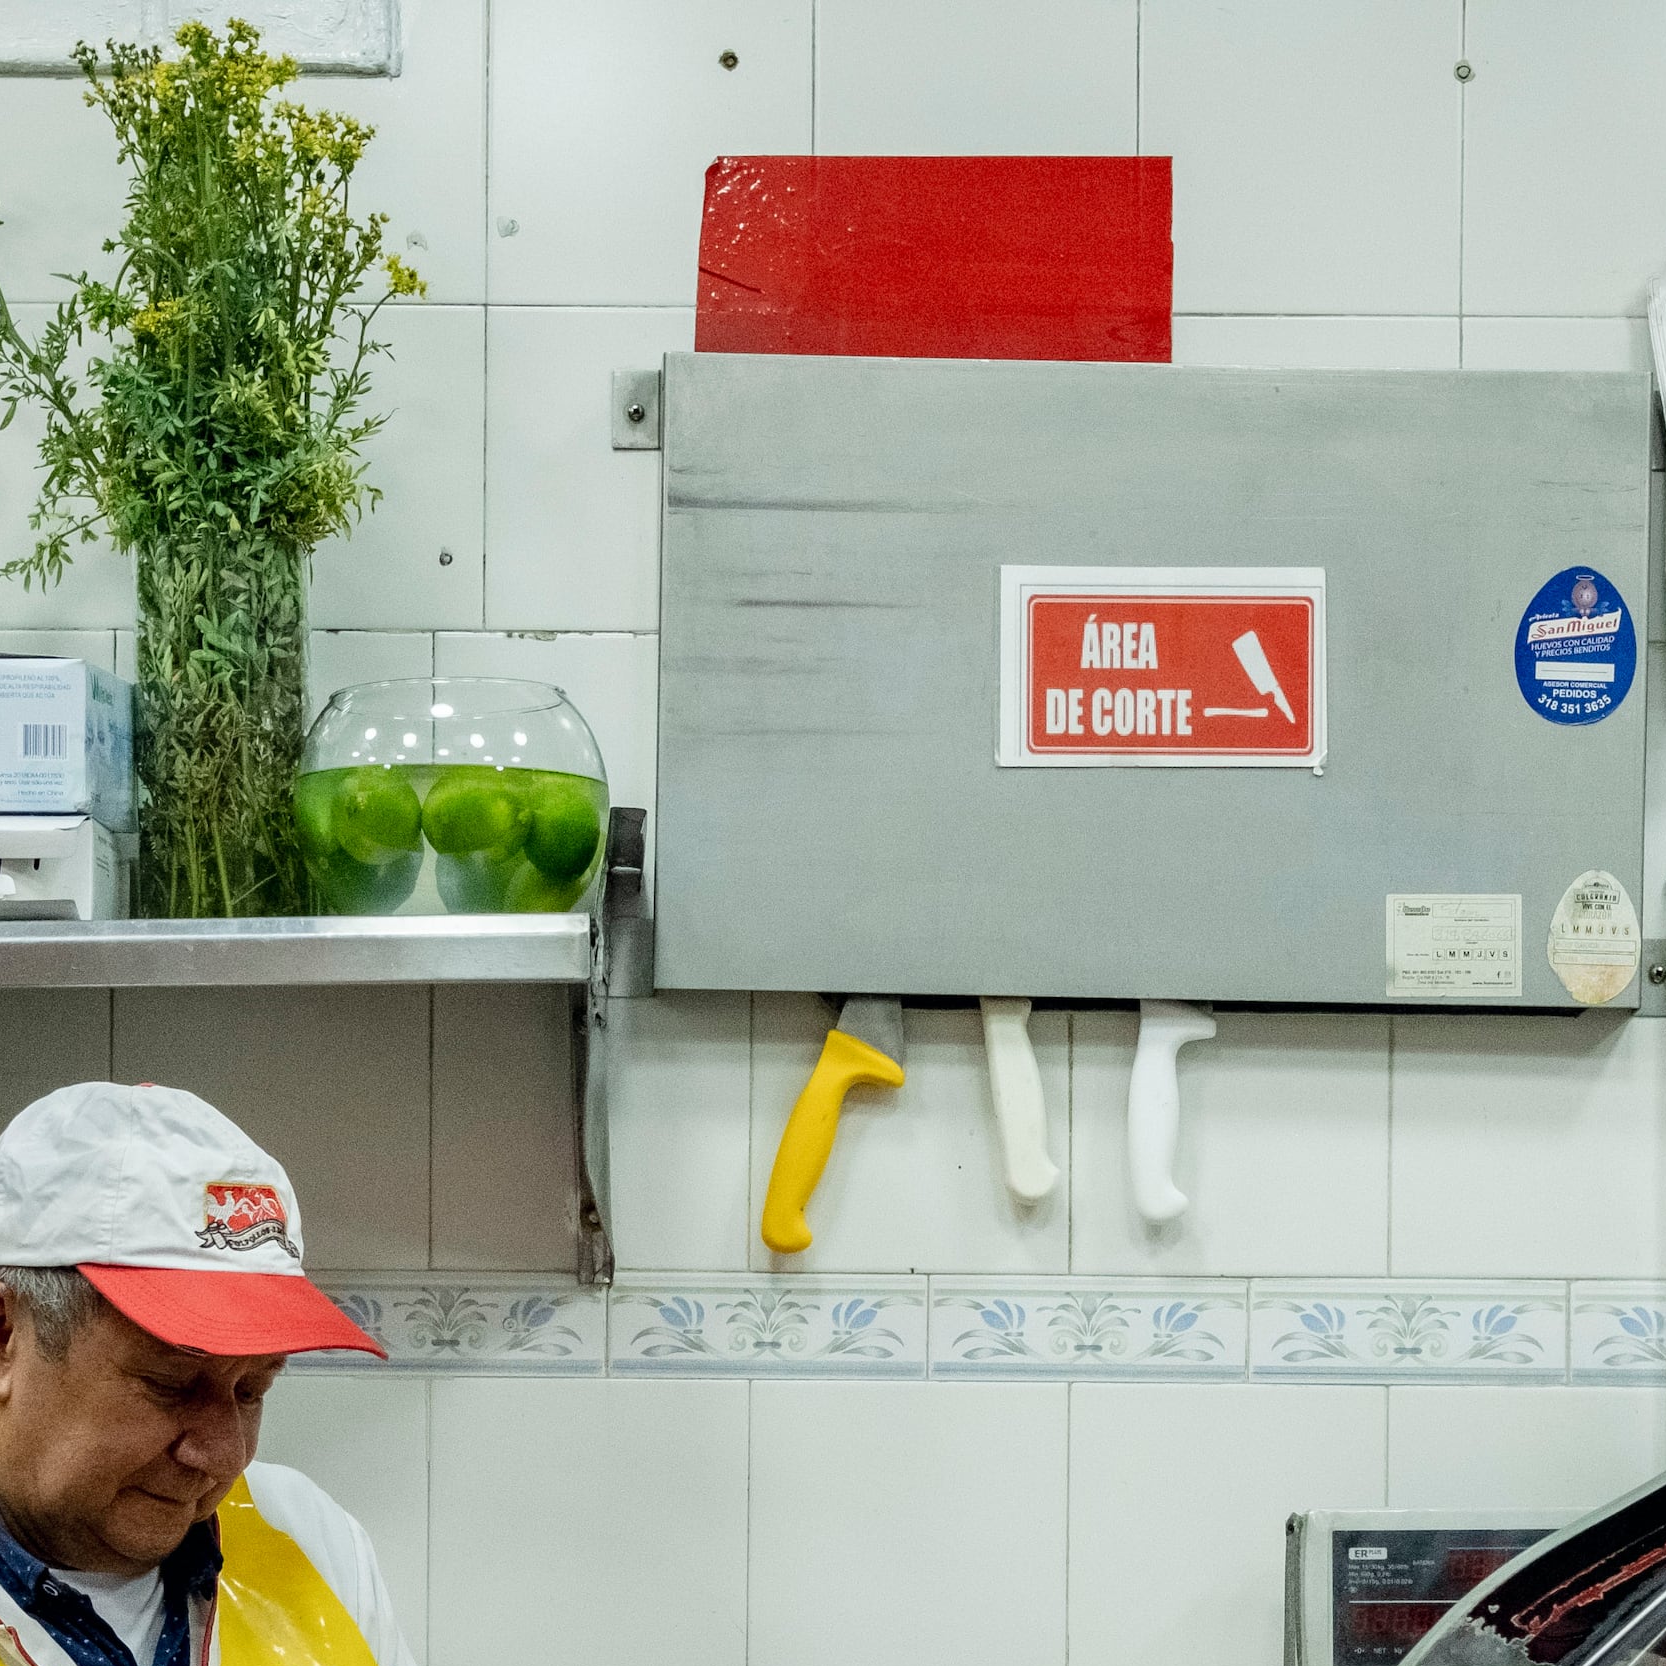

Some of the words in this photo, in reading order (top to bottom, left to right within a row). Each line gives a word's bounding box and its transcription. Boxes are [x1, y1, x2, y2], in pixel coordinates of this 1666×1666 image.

[1565, 618, 1618, 634] Miguel
[1080, 613, 1158, 670] ÁREA
[1531, 640, 1563, 651] HUEVOS
[1562, 638, 1581, 649] CON
[1581, 635, 1615, 647] CALIDAD
[1534, 651, 1541, 659] Y
[1541, 646, 1573, 658] PRECIOS
[1573, 643, 1611, 656] BENDITOS
[1552, 688, 1597, 699] PEDIDOS
[1045, 688, 1084, 735] DE
[1091, 687, 1192, 736] CORTE
[1537, 694, 1559, 711] 318
[1560, 703, 1581, 715] 351
[1584, 694, 1612, 714] 3635
[1573, 925, 1579, 934] M
[1585, 926, 1592, 934] M
[1611, 927, 1618, 936] V
[1624, 927, 1630, 936] S
[1354, 1550, 1368, 1558] ER
